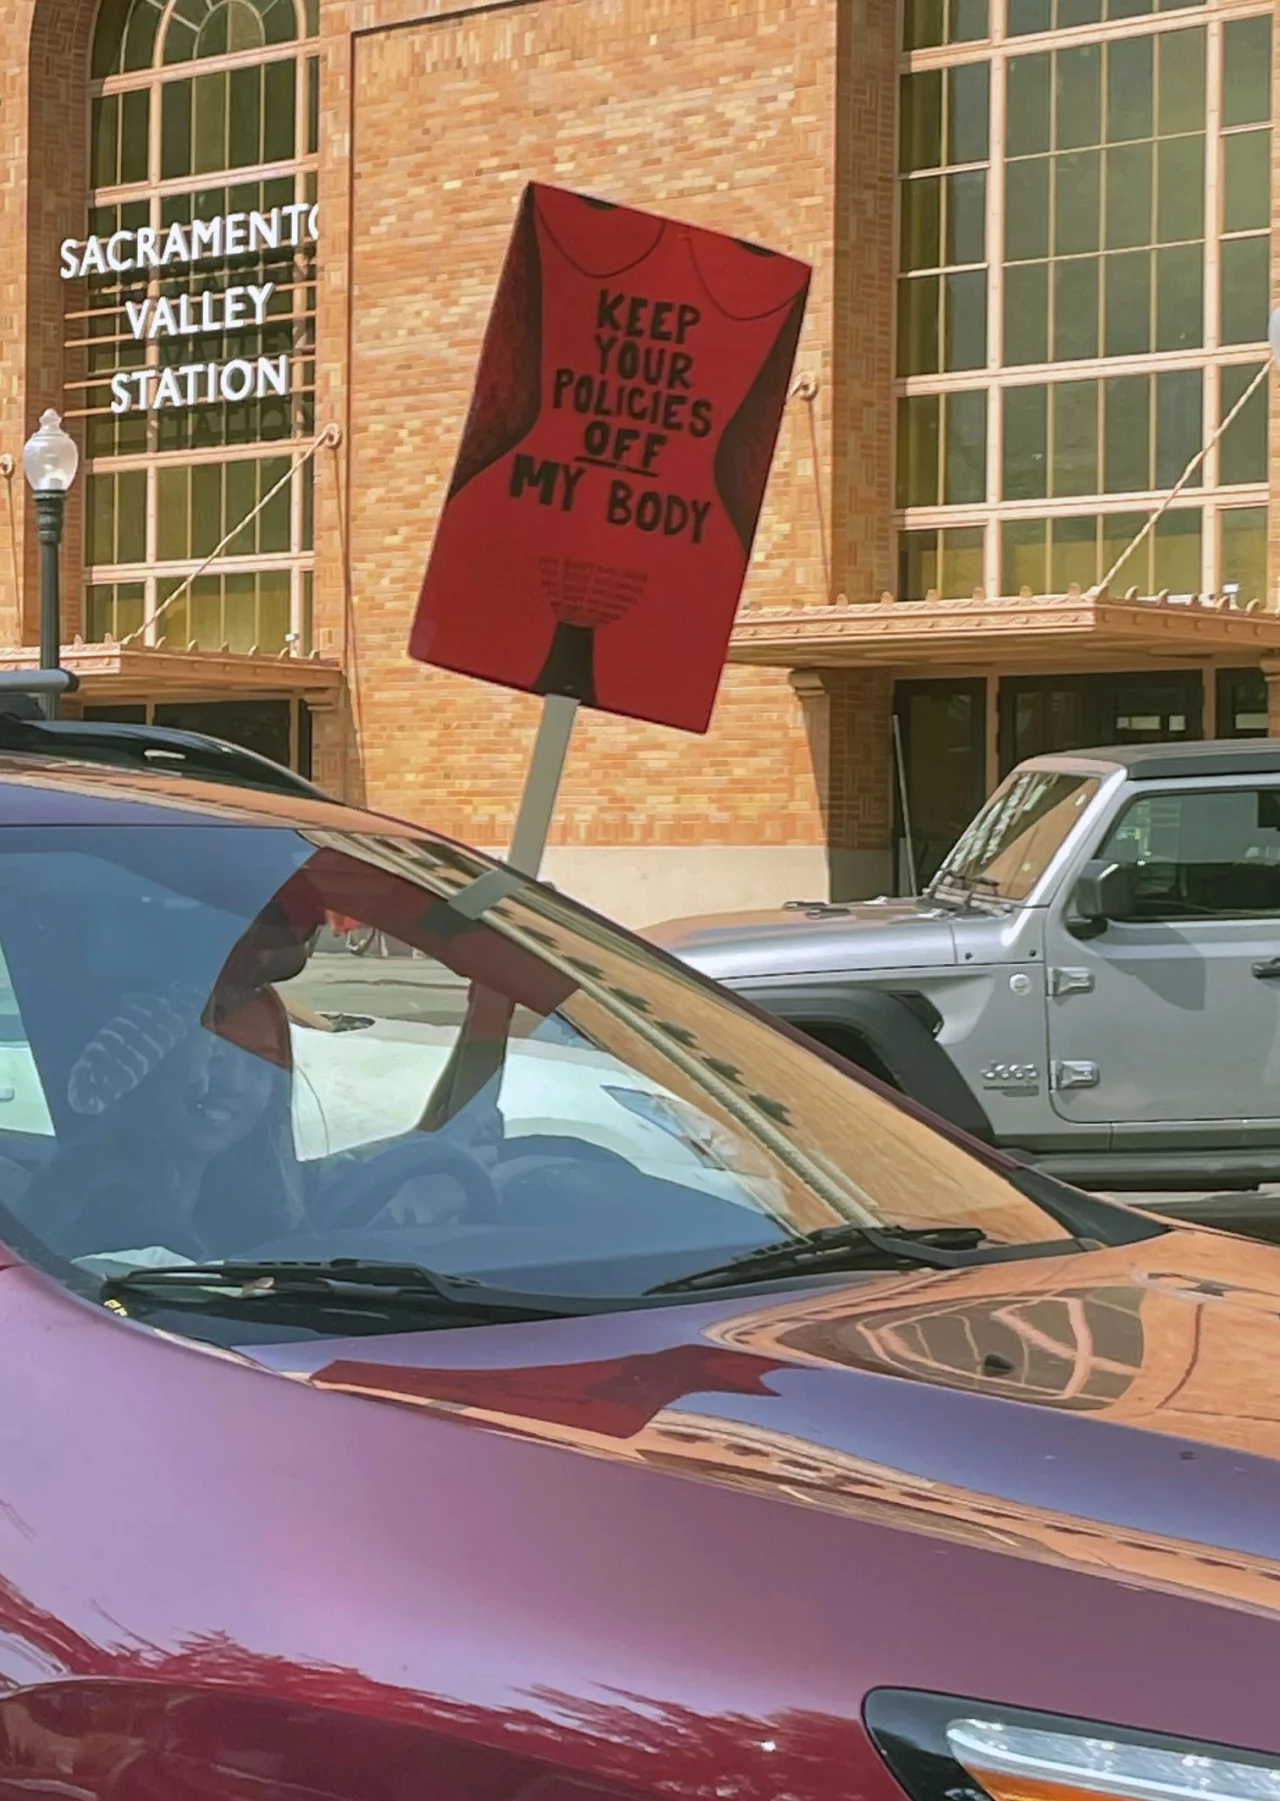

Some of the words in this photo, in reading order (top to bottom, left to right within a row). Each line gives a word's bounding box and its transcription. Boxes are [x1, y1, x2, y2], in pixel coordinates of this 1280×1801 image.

[125, 282, 276, 340] VALLEY
[596, 289, 701, 345] KEEP
[111, 354, 289, 414] STATION
[594, 334, 694, 389] YOUR
[553, 368, 713, 438] POLICIES
[584, 420, 667, 470] OFF
[509, 454, 586, 511] MY
[606, 479, 712, 543] BODY
